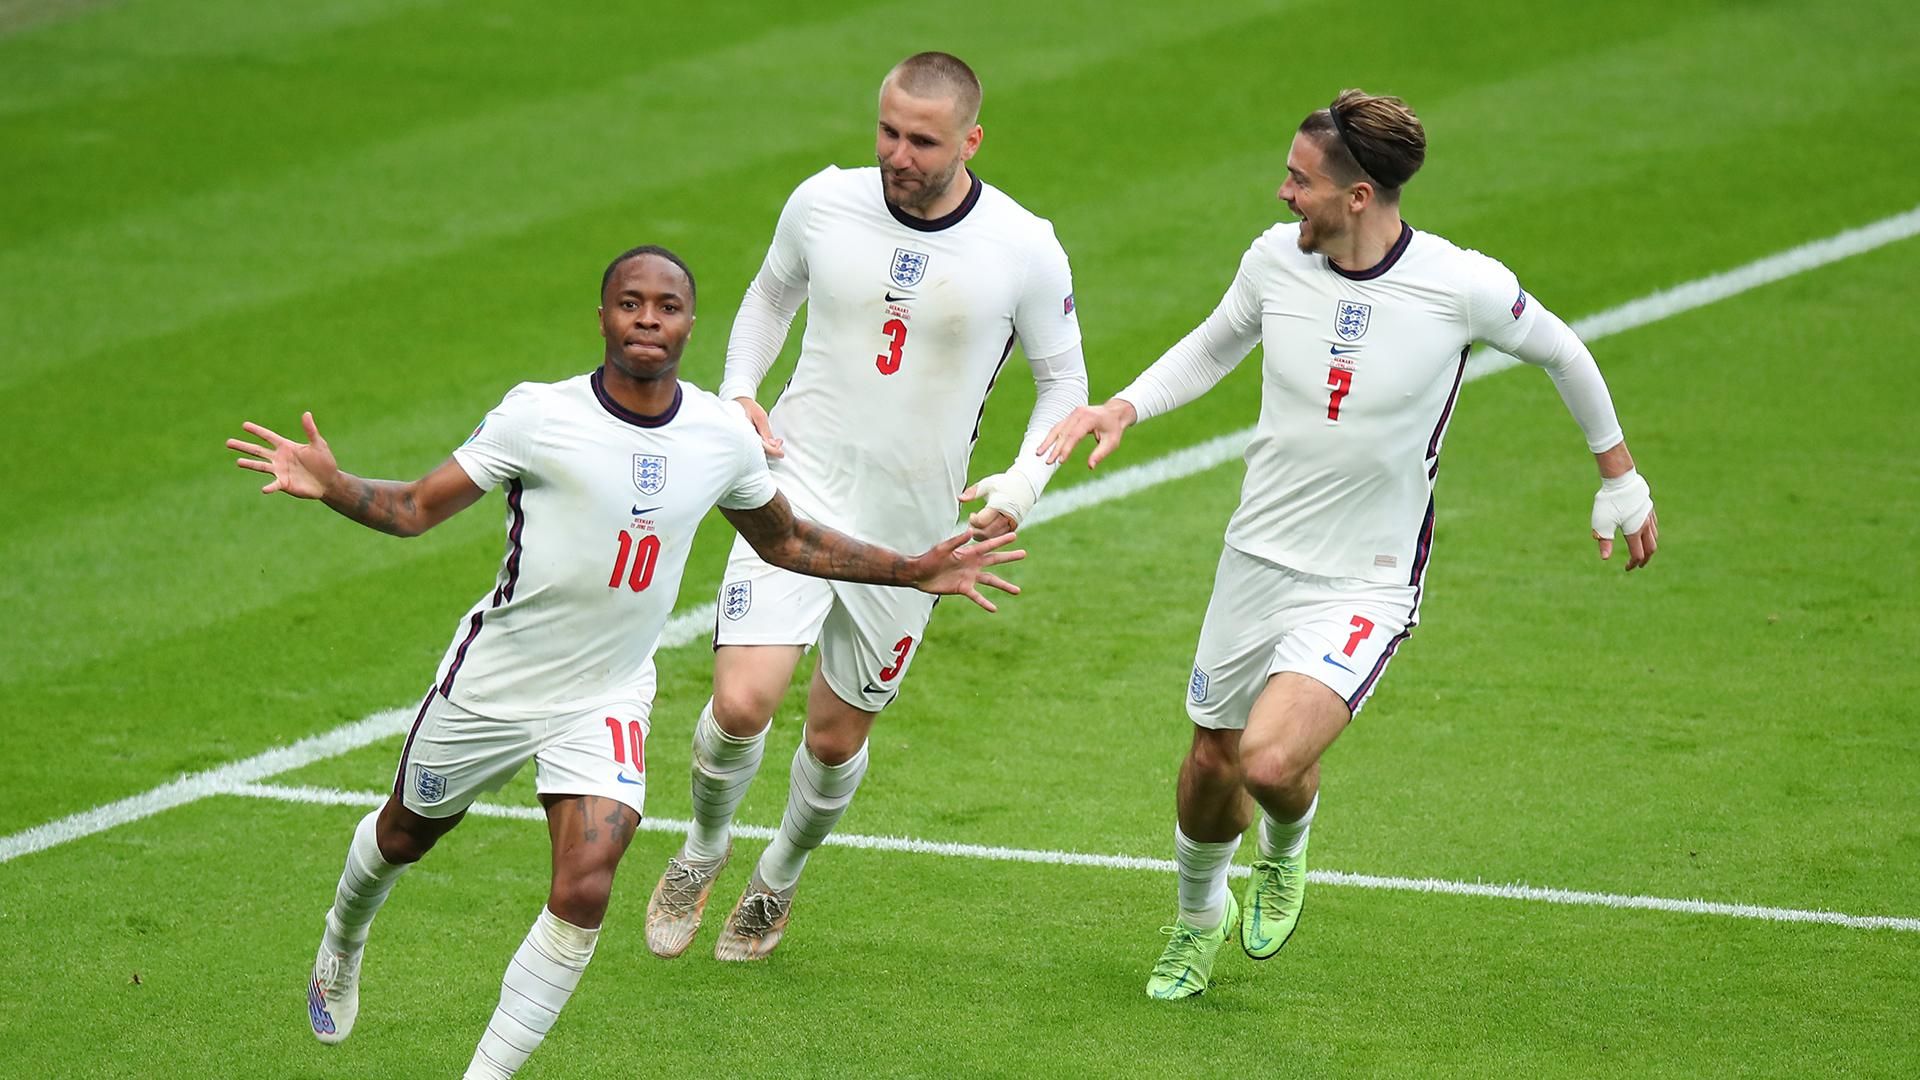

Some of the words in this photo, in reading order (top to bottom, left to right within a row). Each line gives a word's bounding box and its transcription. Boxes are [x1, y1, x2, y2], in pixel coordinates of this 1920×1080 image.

[876, 318, 907, 375] 3
[1327, 367, 1353, 421] 7
[608, 529, 661, 592] 10
[879, 635, 913, 682] 3
[1342, 614, 1375, 658] 7
[605, 716, 644, 774] 10
